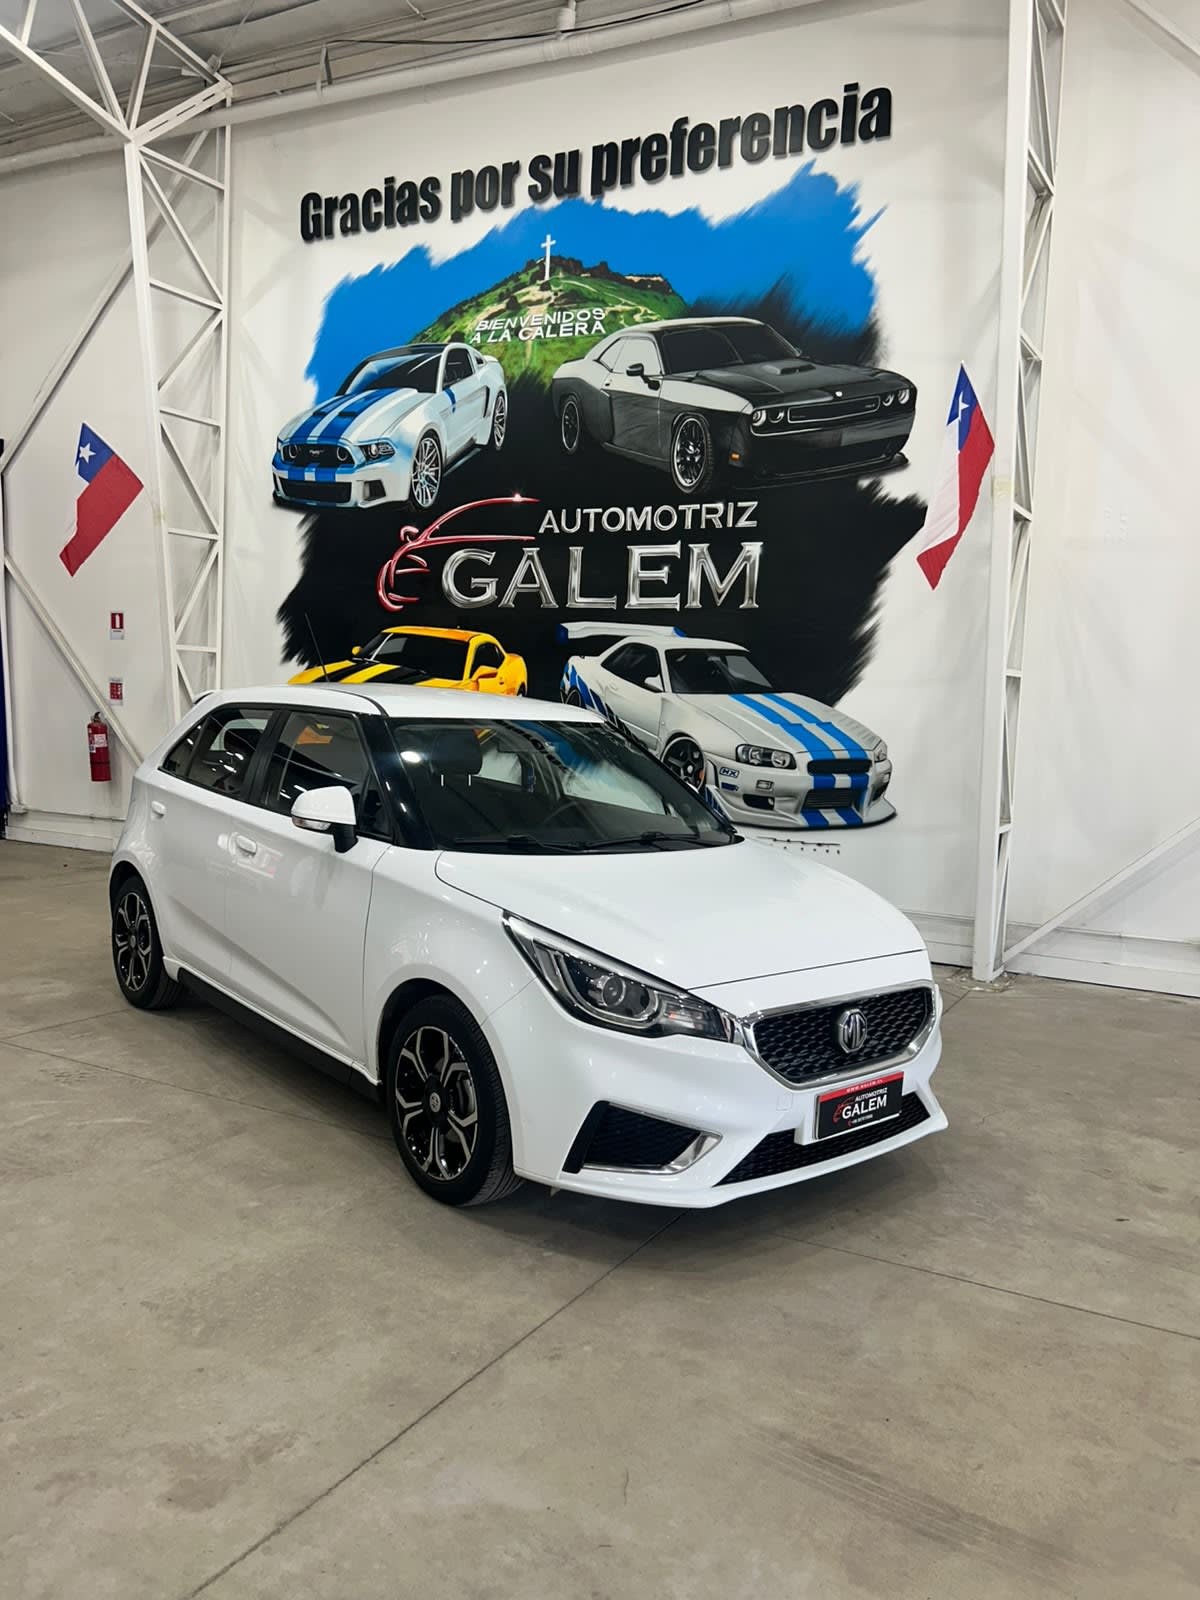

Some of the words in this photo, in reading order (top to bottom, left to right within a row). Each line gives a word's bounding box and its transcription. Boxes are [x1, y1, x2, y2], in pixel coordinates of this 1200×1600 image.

[300, 176, 441, 243] Gracias
[450, 160, 520, 222] por
[528, 149, 580, 202] su
[590, 82, 892, 196] preferencia
[475, 307, 606, 331] BIENVENIDOS
[469, 332, 481, 344] A
[487, 329, 512, 343] LA
[518, 320, 606, 340] CALERA
[538, 501, 759, 533] AUTOMOTRIZ
[441, 540, 764, 611] GALEM
[842, 1094, 887, 1119] GALEM
[855, 1087, 888, 1102] AUTOMOTRIZ
